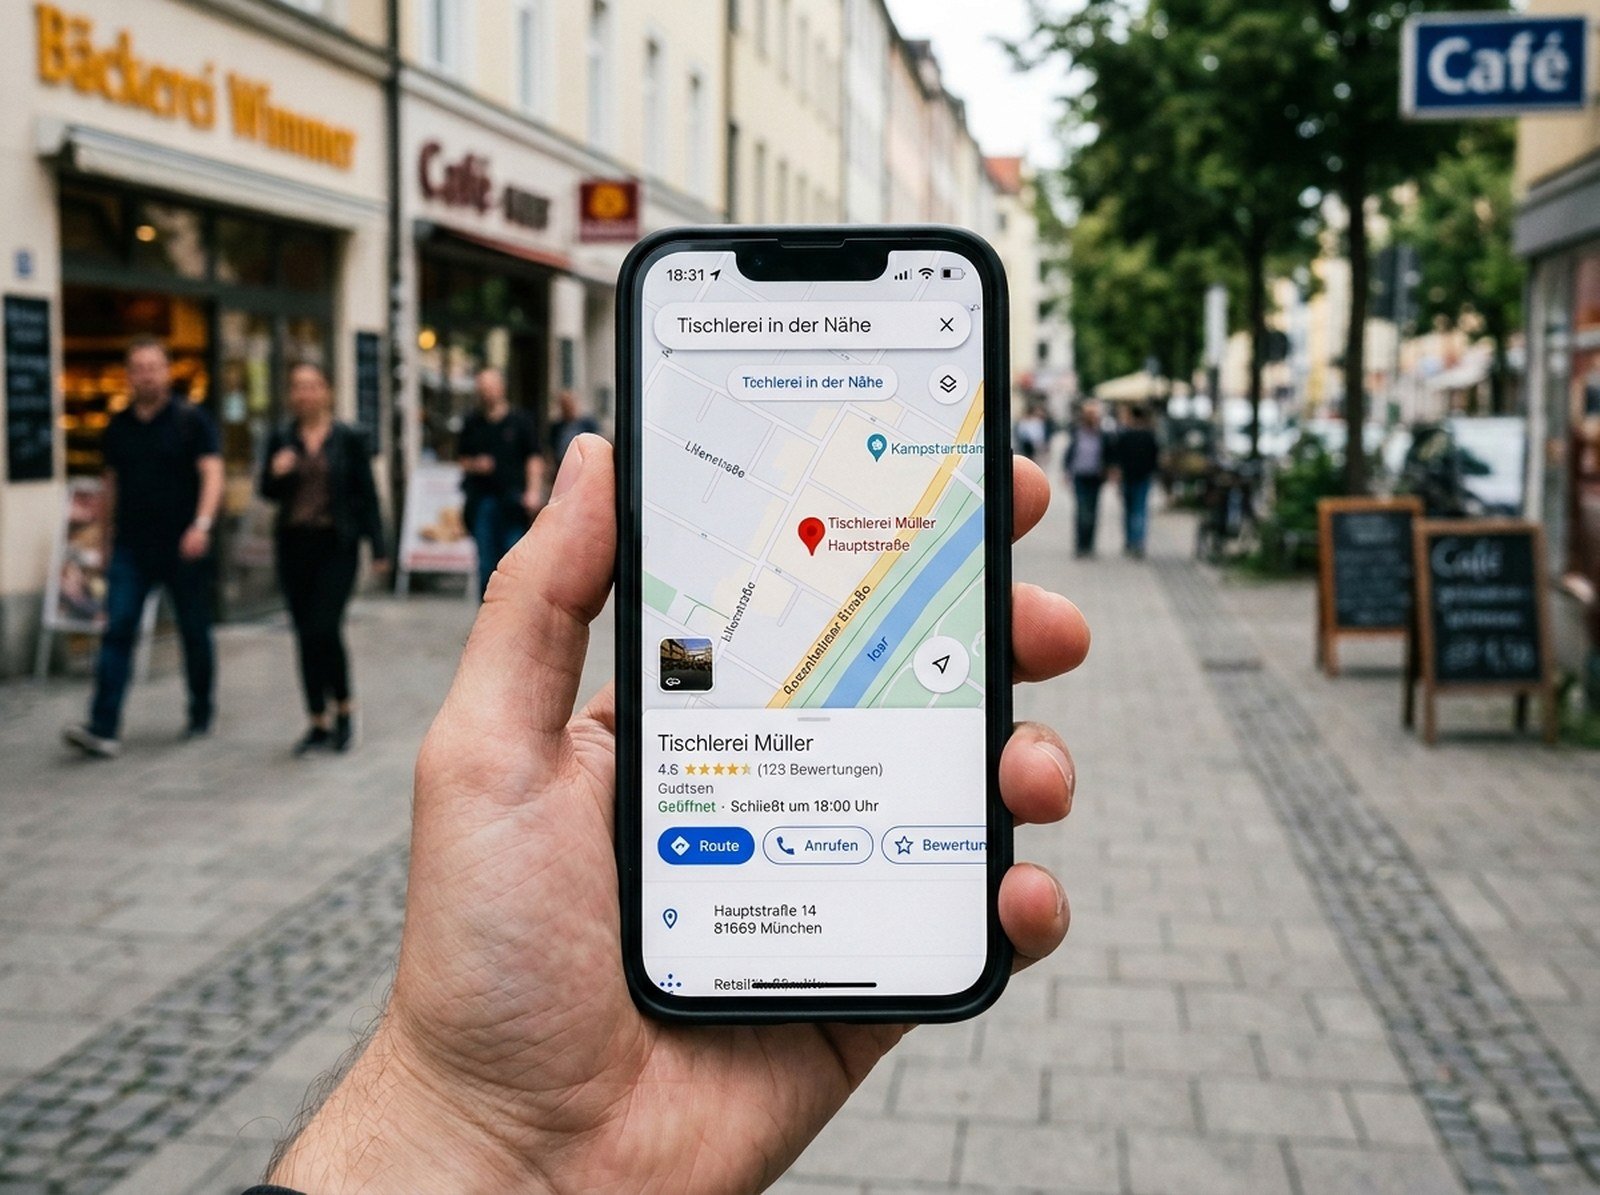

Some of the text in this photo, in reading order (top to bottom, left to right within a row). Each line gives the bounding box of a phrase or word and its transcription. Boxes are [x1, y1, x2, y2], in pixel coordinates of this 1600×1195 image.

[1427, 30, 1569, 95] Café
[667, 269, 704, 282] 18:31
[677, 316, 872, 334] Tischlerei in der Nähe
[806, 375, 818, 388] in
[821, 375, 845, 388] der
[828, 516, 937, 530] Tischlerei Müller
[828, 538, 910, 554] Hauptstraße
[658, 733, 814, 752] Tischlerei Müller
[757, 762, 787, 777] (123
[790, 762, 883, 778] Bewertungen)
[789, 803, 810, 813] um
[814, 800, 851, 813] 18:00
[855, 800, 880, 813] Uhr
[699, 839, 740, 853] Route
[804, 838, 859, 852] Anrufen
[801, 904, 817, 917] 14
[714, 921, 822, 935] 81669 München
